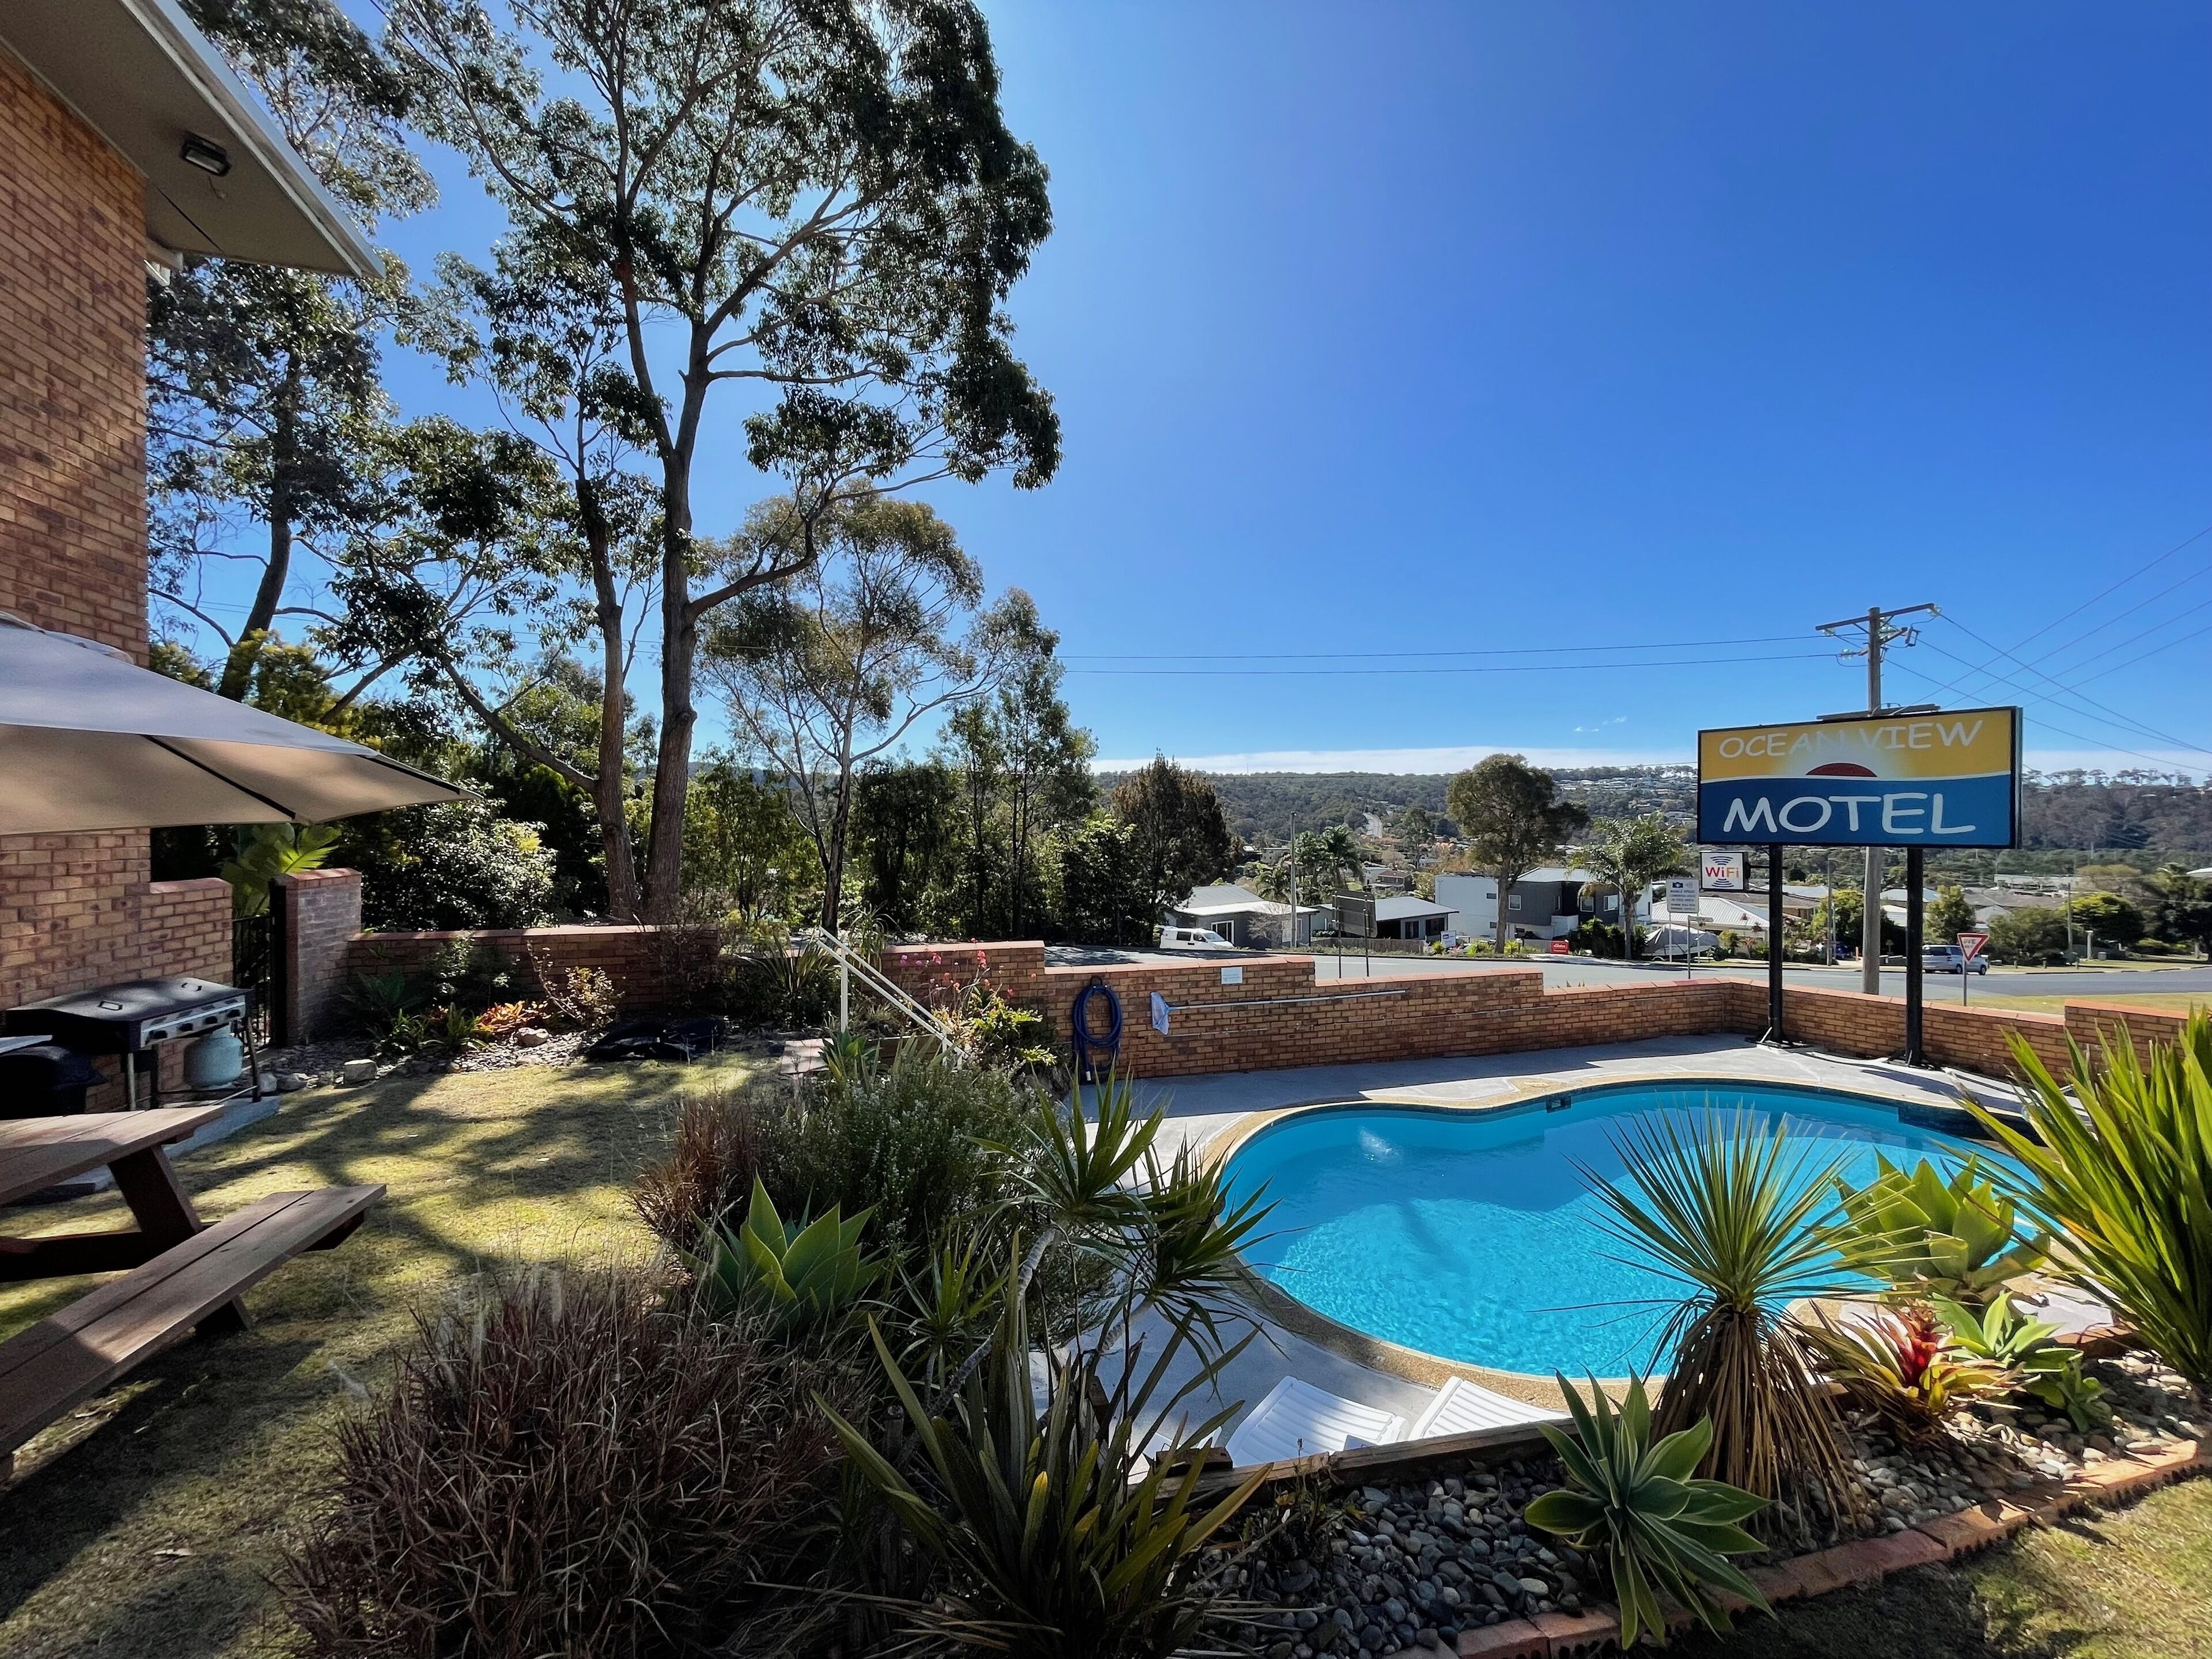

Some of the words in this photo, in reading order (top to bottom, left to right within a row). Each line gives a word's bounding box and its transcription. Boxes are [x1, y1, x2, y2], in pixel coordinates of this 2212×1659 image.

[1719, 729, 1847, 758] OCEAN
[1858, 720, 1983, 749] VIEW
[1723, 792, 1976, 834] MOTEL
[1705, 866, 1740, 878] WiFi
